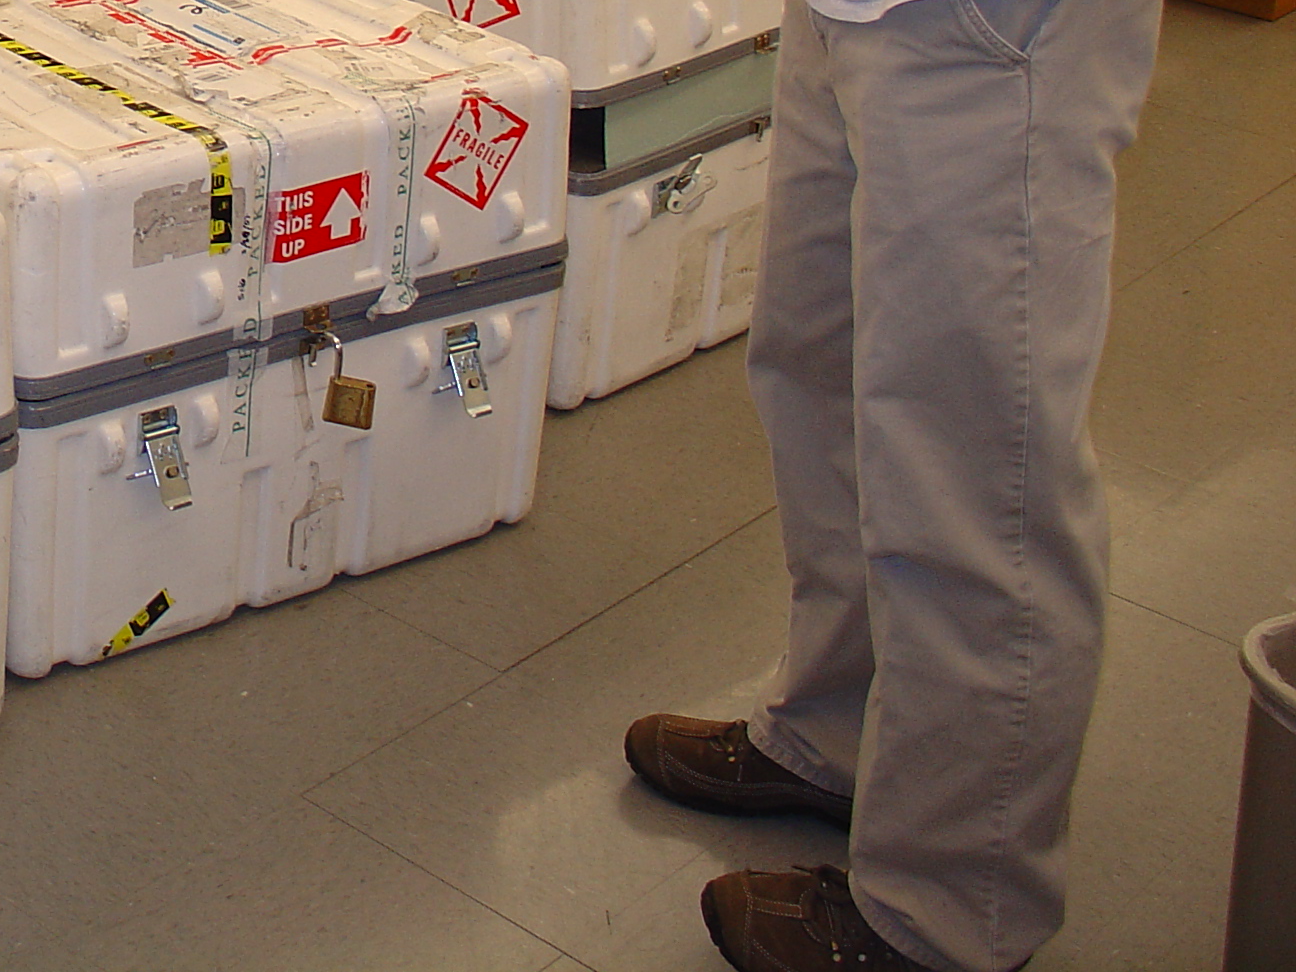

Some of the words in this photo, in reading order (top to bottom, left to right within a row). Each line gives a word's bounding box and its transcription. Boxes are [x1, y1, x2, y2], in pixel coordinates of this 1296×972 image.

[452, 128, 505, 170] FRAGILE
[274, 190, 314, 213] THIS
[272, 213, 313, 236] SIDE
[281, 238, 305, 258] UP
